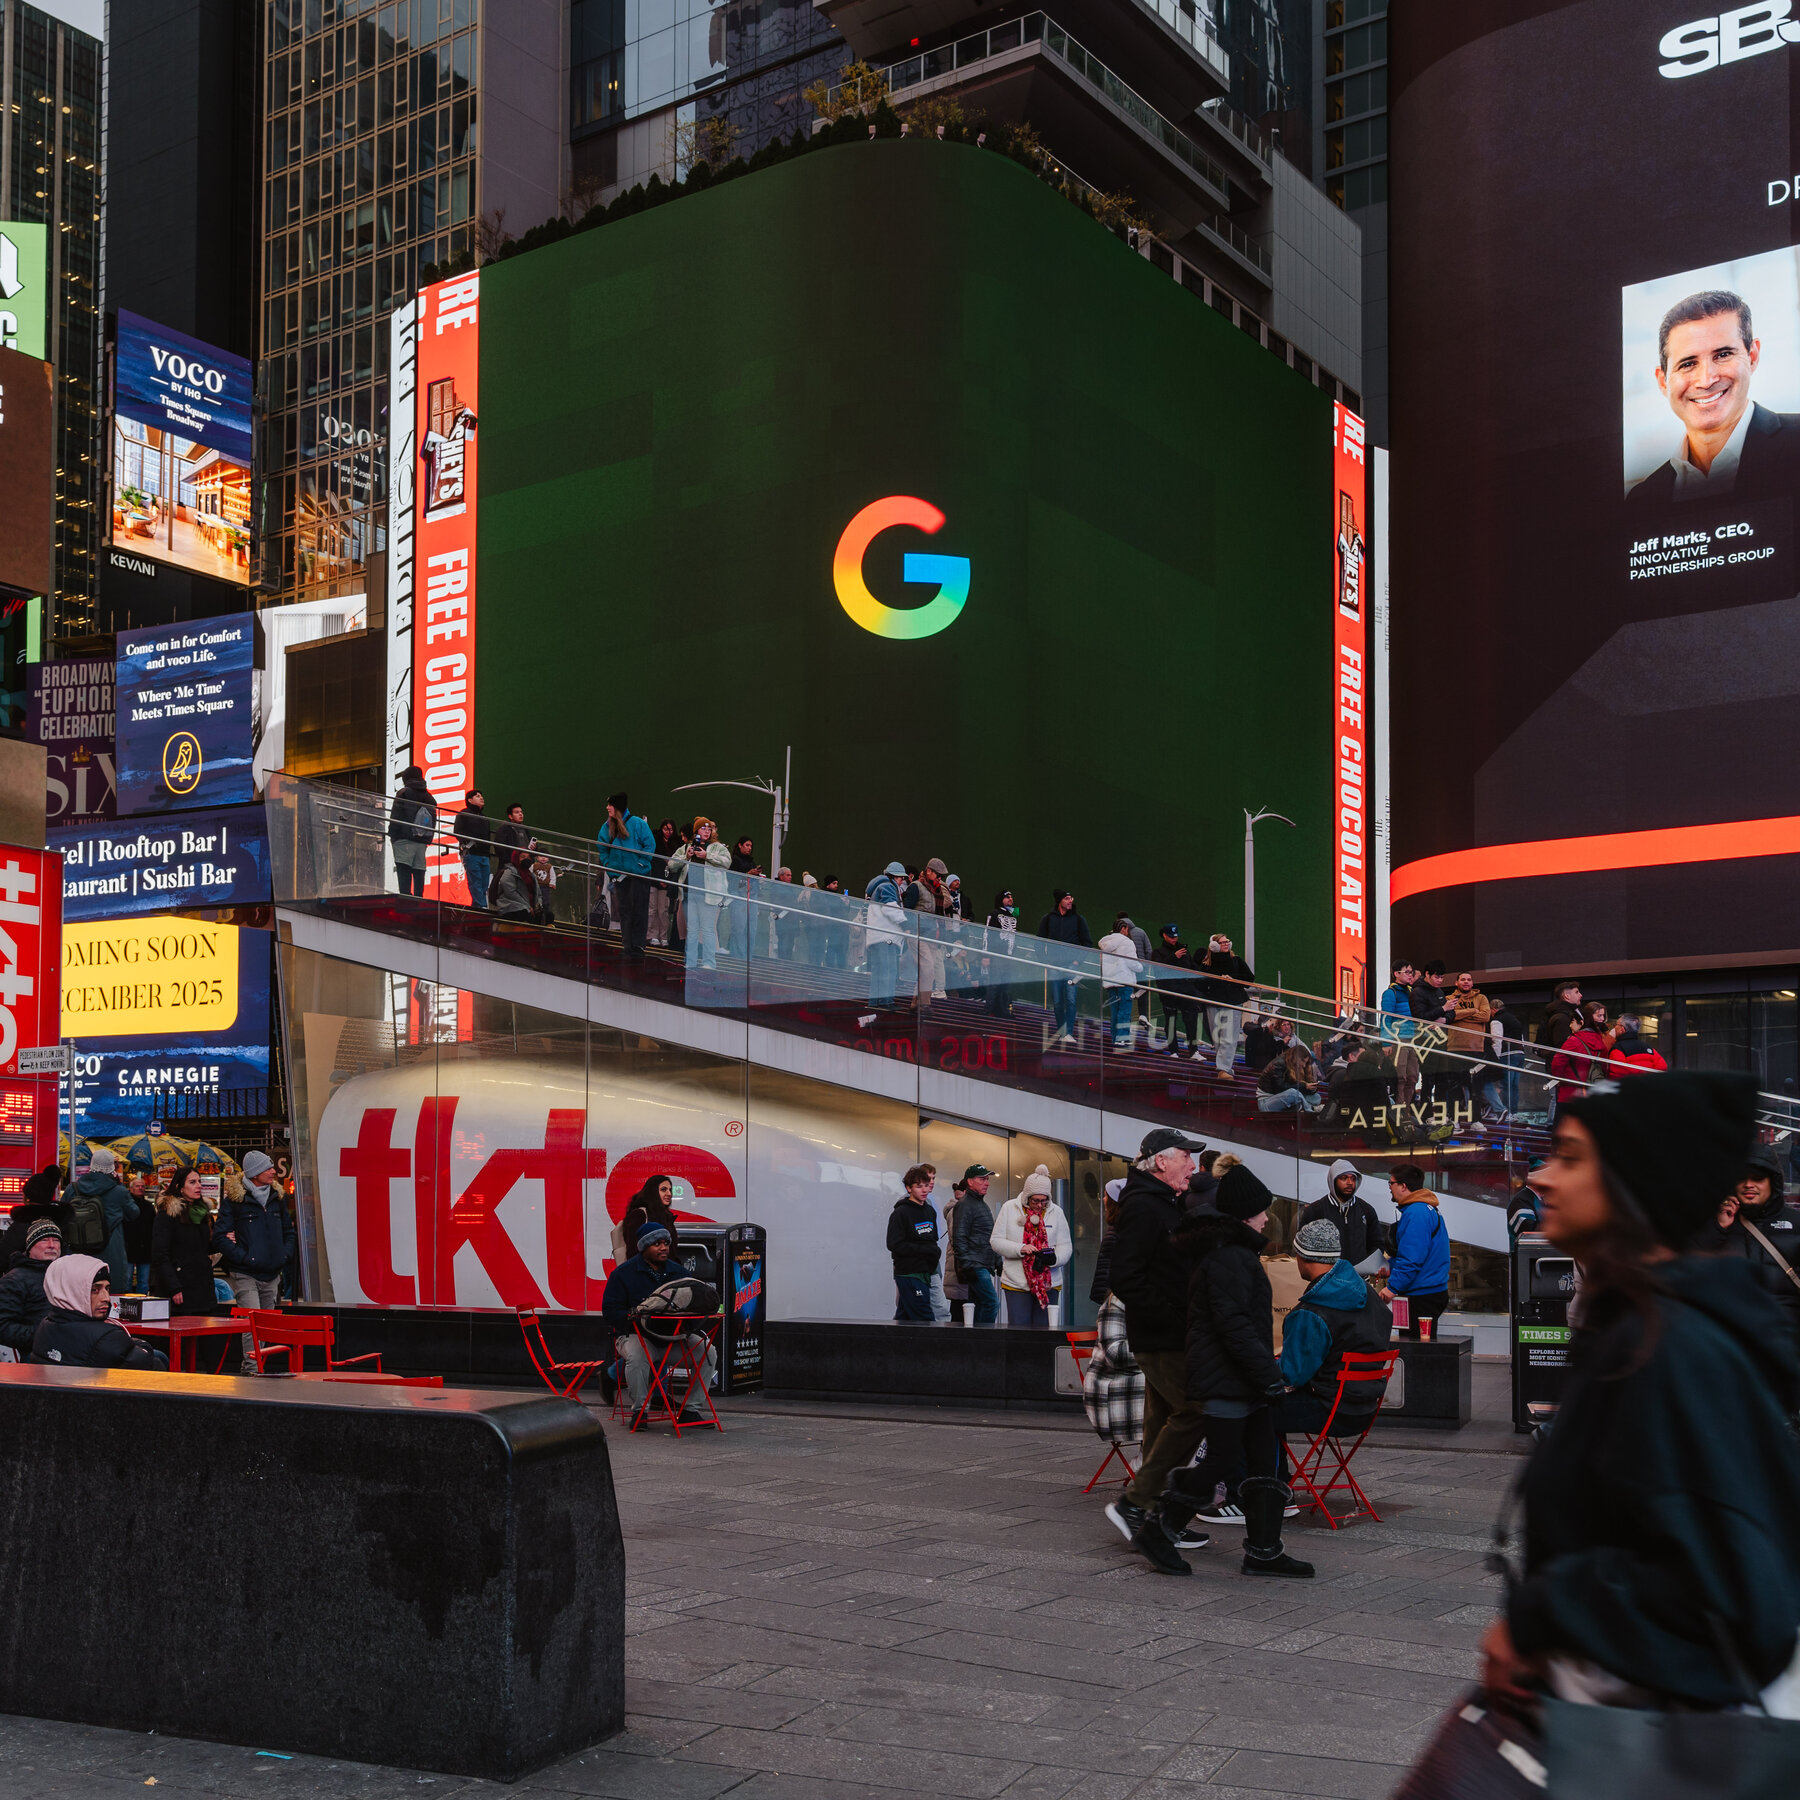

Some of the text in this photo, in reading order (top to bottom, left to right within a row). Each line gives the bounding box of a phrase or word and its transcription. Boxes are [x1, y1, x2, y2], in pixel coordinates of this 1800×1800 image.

[170, 381, 202, 401] BY IHG
[159, 393, 212, 421] Times Square
[166, 409, 205, 432] Broadway
[1629, 522, 1754, 554] Jeff Marks, CEO,
[110, 552, 156, 577] KEVANI
[1630, 545, 1709, 567] INNOVATIVE
[1630, 547, 1775, 580] PARTNERSHIPS GROUP
[426, 547, 469, 646] FREE
[126, 628, 242, 656] Come on in for Comfort
[146, 649, 217, 671] and voco Life.
[137, 689, 172, 704] Where
[131, 697, 235, 723] Meets Times Square
[1340, 643, 1363, 939] FREE CHOCOLATE
[98, 834, 176, 863] Rooftop
[181, 831, 217, 854] Bar
[142, 865, 196, 891] Sushi
[201, 863, 237, 886] Bar
[147, 932, 218, 962] SOON
[61, 979, 223, 1013] CEMBER 2025
[20, 1049, 65, 1060] PEDESTRIAN FLOW ZONE
[40, 1059, 65, 1069] KEEP MOVING
[118, 1066, 220, 1085] CARNEGIE
[74, 1097, 92, 1106] quare
[119, 1084, 219, 1097] DINER & CAFE
[339, 1096, 737, 1312] tkts
[733, 1277, 762, 1313] AMAZE
[1521, 1330, 1561, 1340] TIMES
